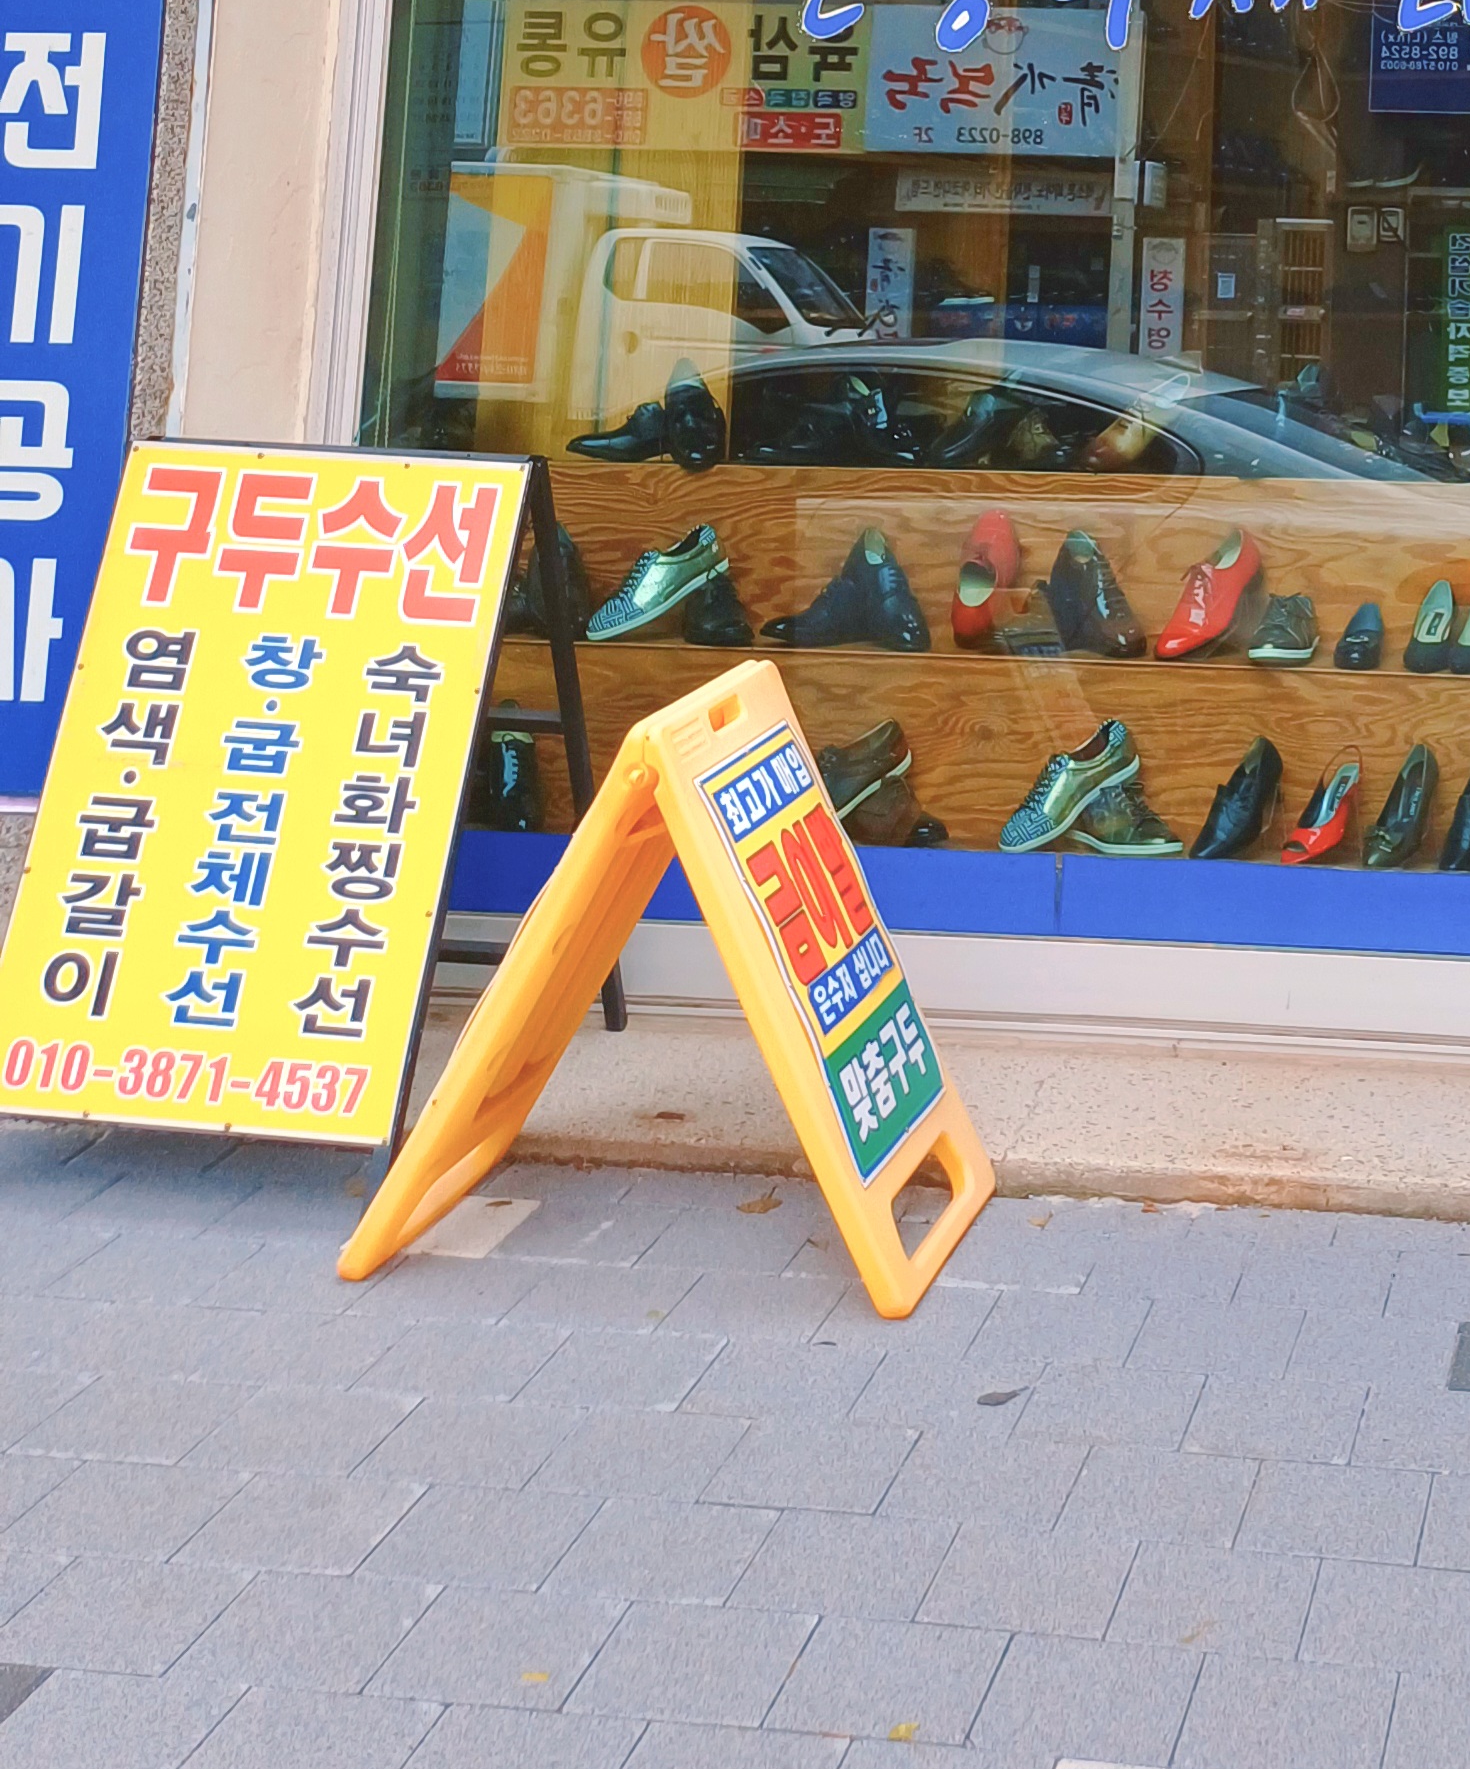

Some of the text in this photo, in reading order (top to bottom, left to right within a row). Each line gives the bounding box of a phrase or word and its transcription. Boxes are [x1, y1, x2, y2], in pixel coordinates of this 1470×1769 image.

[127, 465, 500, 623] 구두수선
[719, 744, 813, 833] 최고가 매입
[746, 801, 874, 987] 금이빨
[812, 971, 855, 1026] 은수저
[2, 1038, 370, 1115] 010-3871-4537
[838, 1004, 928, 1144] 맞춤구두
